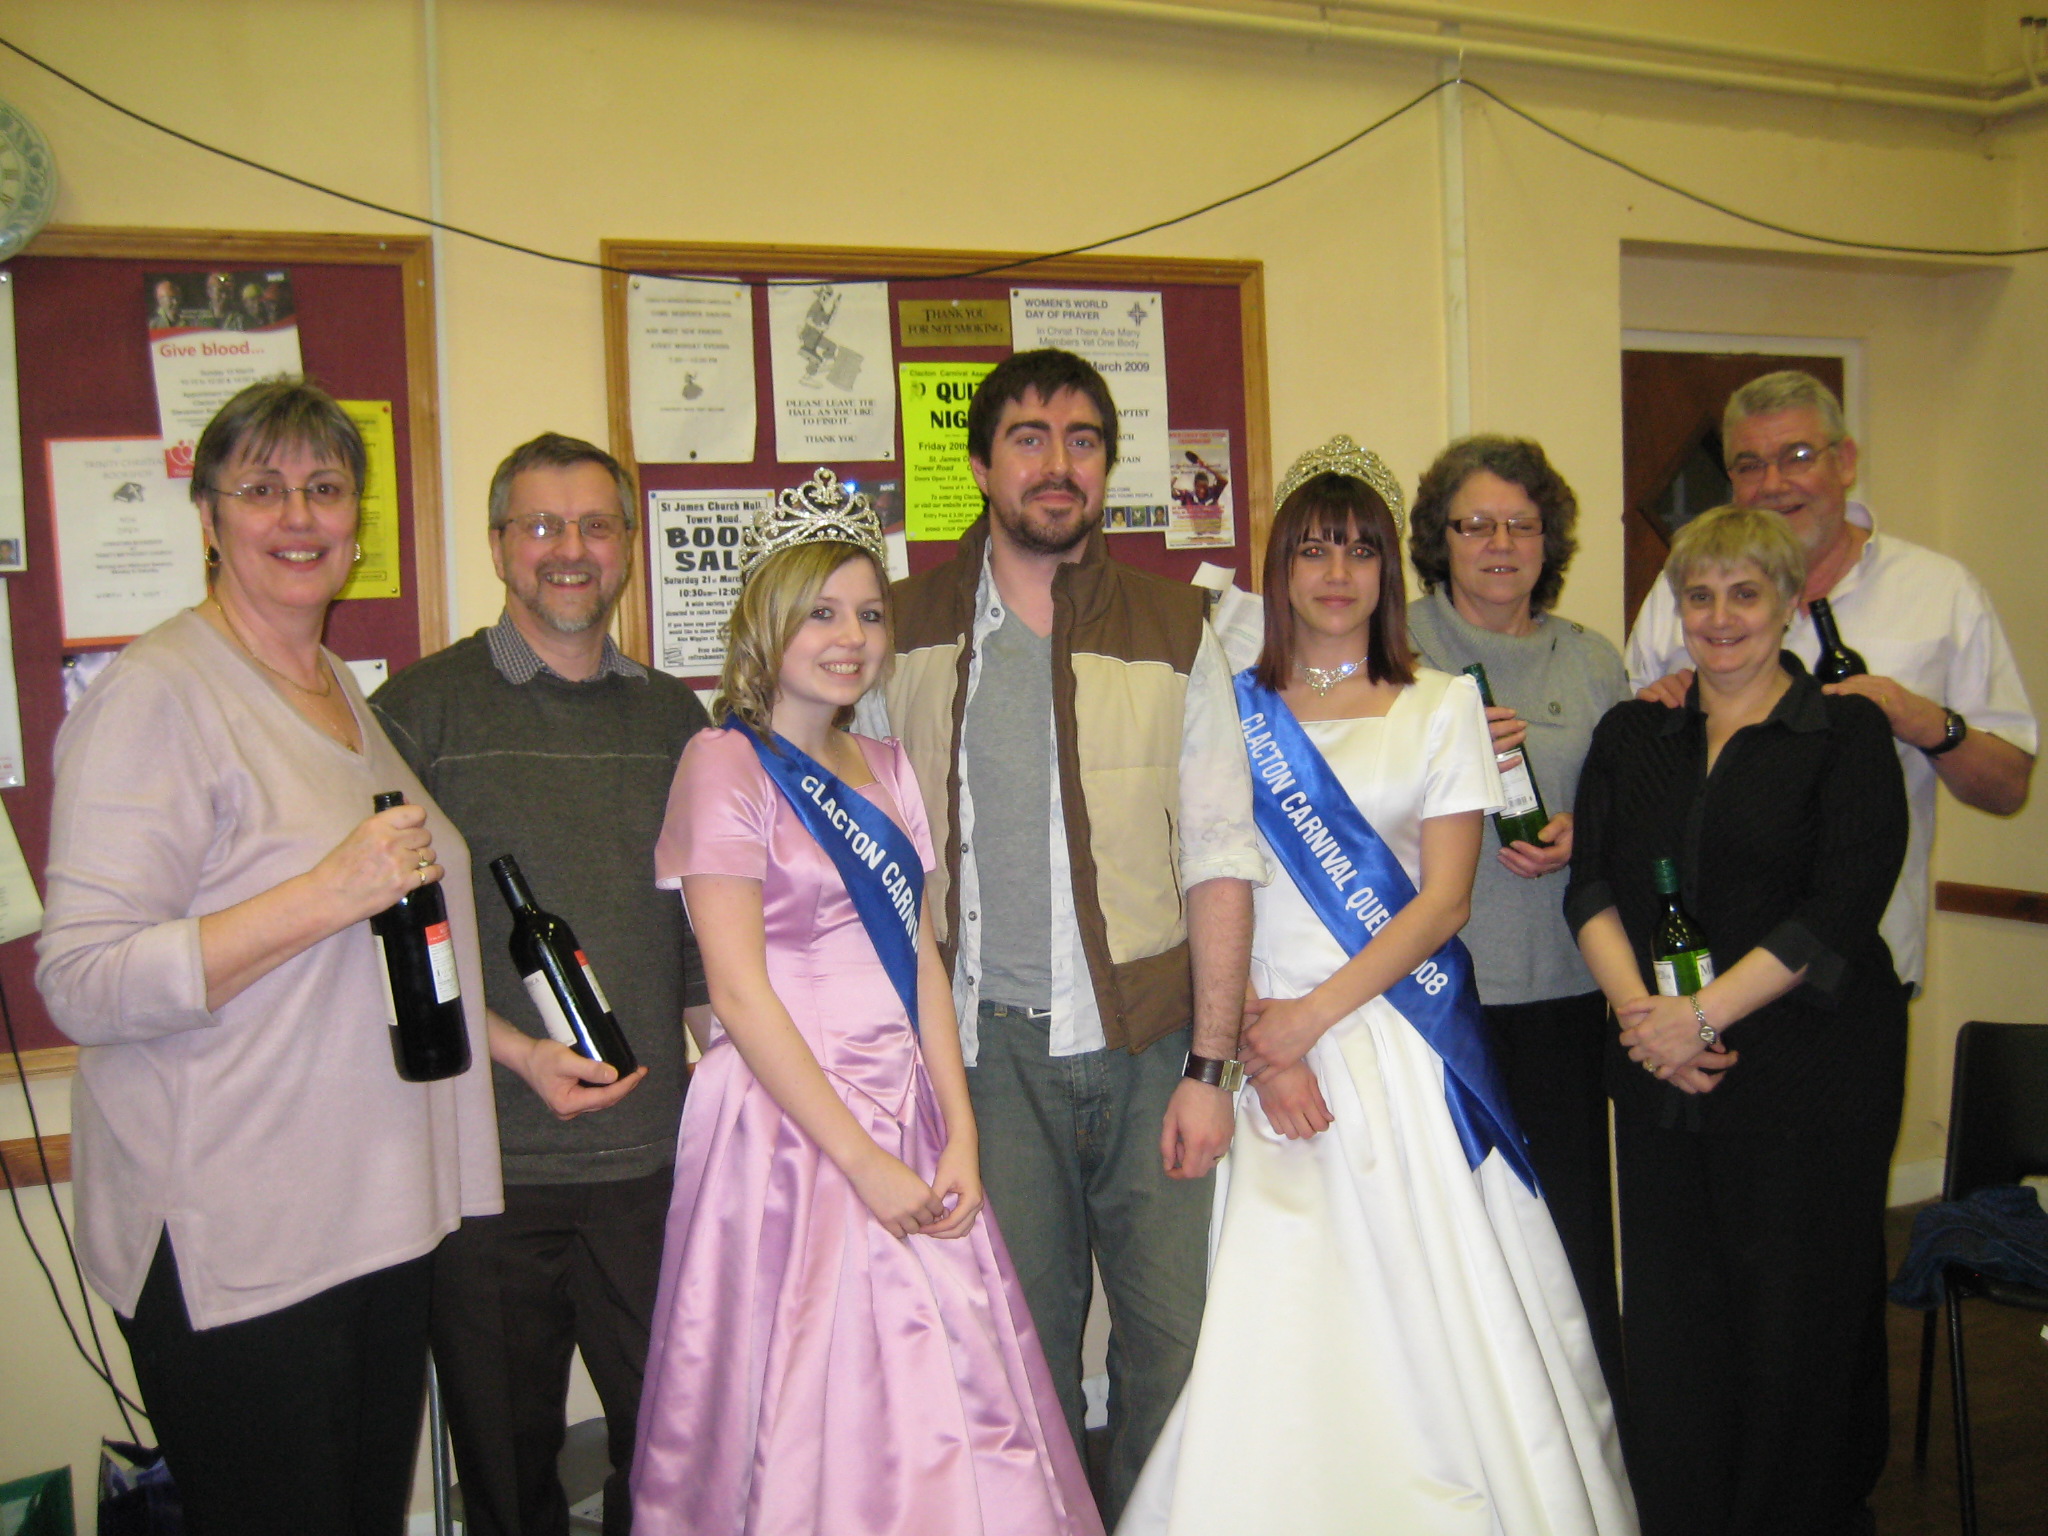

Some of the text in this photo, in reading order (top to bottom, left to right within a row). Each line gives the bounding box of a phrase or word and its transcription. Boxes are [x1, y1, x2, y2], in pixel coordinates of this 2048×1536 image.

[1024, 298, 1108, 310] WOMEN'S WORLD
[923, 308, 984, 322] THANK YOU
[1025, 310, 1100, 320] DAY OF PRAYER
[907, 324, 929, 335] FOR
[931, 324, 952, 335] NOT
[1036, 327, 1140, 338] In Christ There Are Many
[1039, 337, 1079, 346] Members
[1117, 338, 1139, 349] Body
[160, 343, 196, 358] Give
[1124, 361, 1150, 372] 2009
[940, 369, 968, 377] Carnival
[936, 382, 980, 404] QUI
[786, 399, 875, 407] PLEASE LEAVE THE
[788, 408, 812, 416] HALL
[817, 408, 831, 416] AS
[833, 408, 852, 416] YOU
[1115, 408, 1150, 418] APTIST
[803, 417, 815, 425] TO
[816, 417, 838, 425] FIND
[930, 410, 968, 429] NIG
[805, 435, 856, 443] THANK YOU
[918, 442, 969, 452] Friday 20th
[940, 455, 961, 463] James
[914, 464, 954, 472] Tower Road
[879, 483, 896, 491] NHS
[661, 501, 761, 512] St James Church Hall
[686, 514, 712, 524] Tower
[675, 549, 740, 572] SAL
[664, 575, 699, 586] Saturday
[719, 574, 743, 584] Marc
[801, 775, 887, 870] CLACTON
[1240, 712, 1296, 795] CLACTON
[1281, 791, 1358, 892] CARNIVAL
[1345, 886, 1392, 937] QUE
